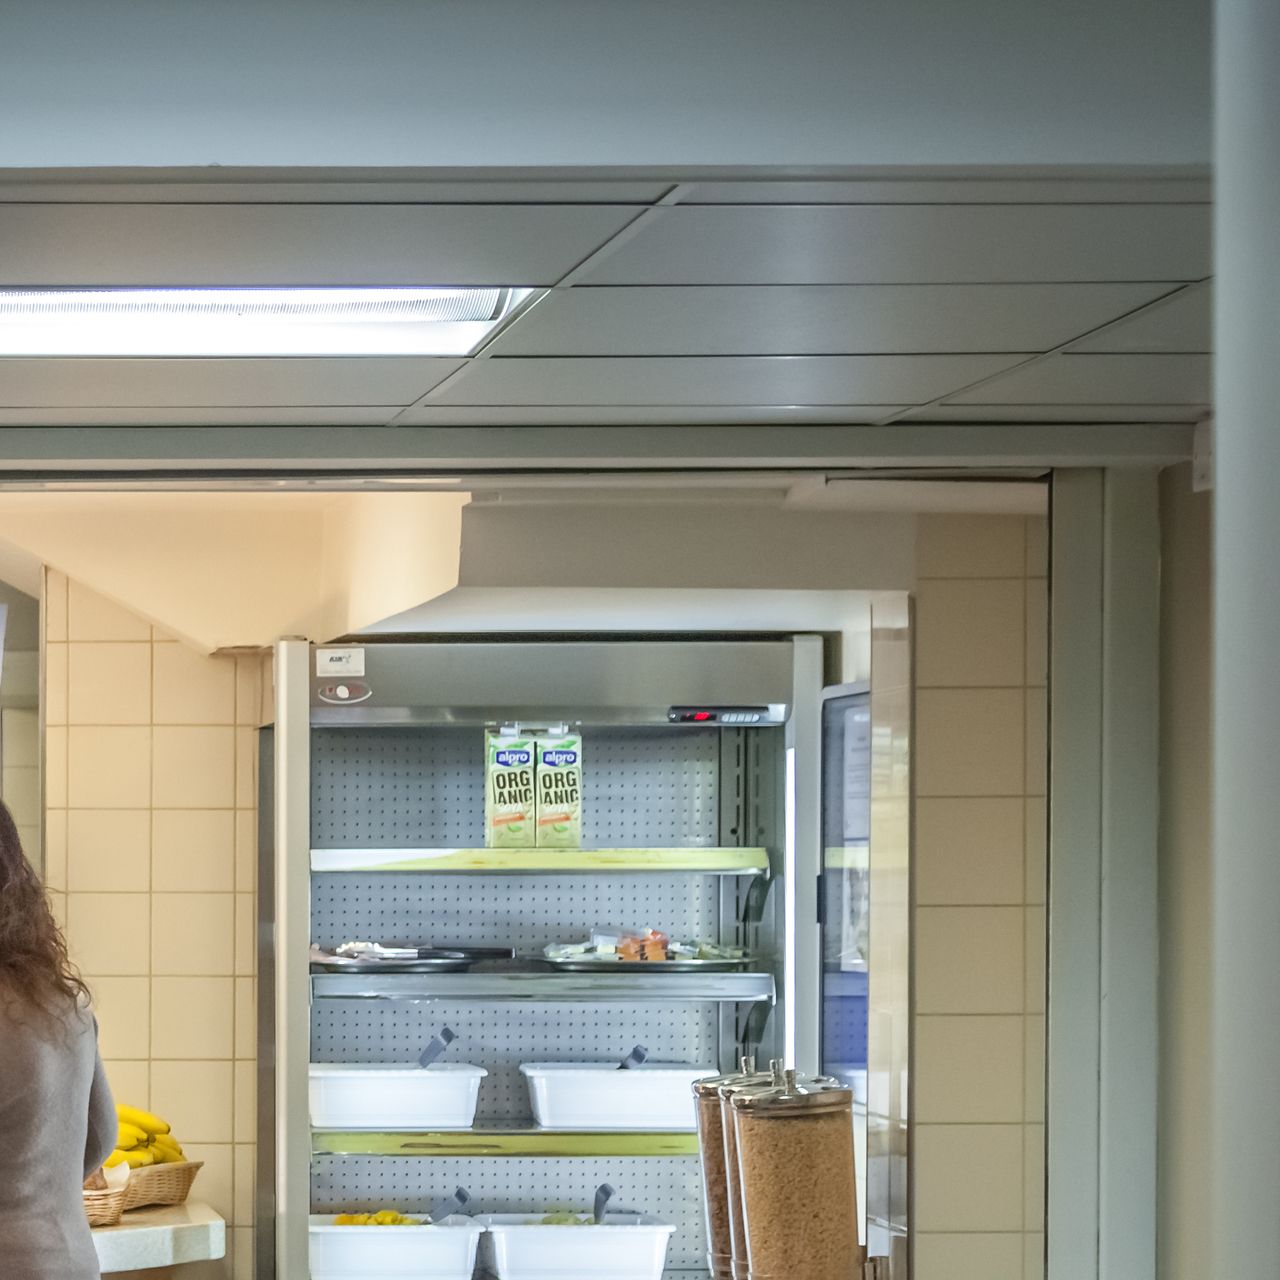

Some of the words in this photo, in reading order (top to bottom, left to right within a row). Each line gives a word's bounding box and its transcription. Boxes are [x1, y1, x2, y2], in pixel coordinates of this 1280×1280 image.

[498, 752, 528, 764] alpro
[545, 752, 575, 764] alpro
[495, 771, 530, 789] ORG
[542, 771, 576, 789] ORG
[498, 789, 532, 804] ANIC
[544, 789, 578, 804] ANIC
